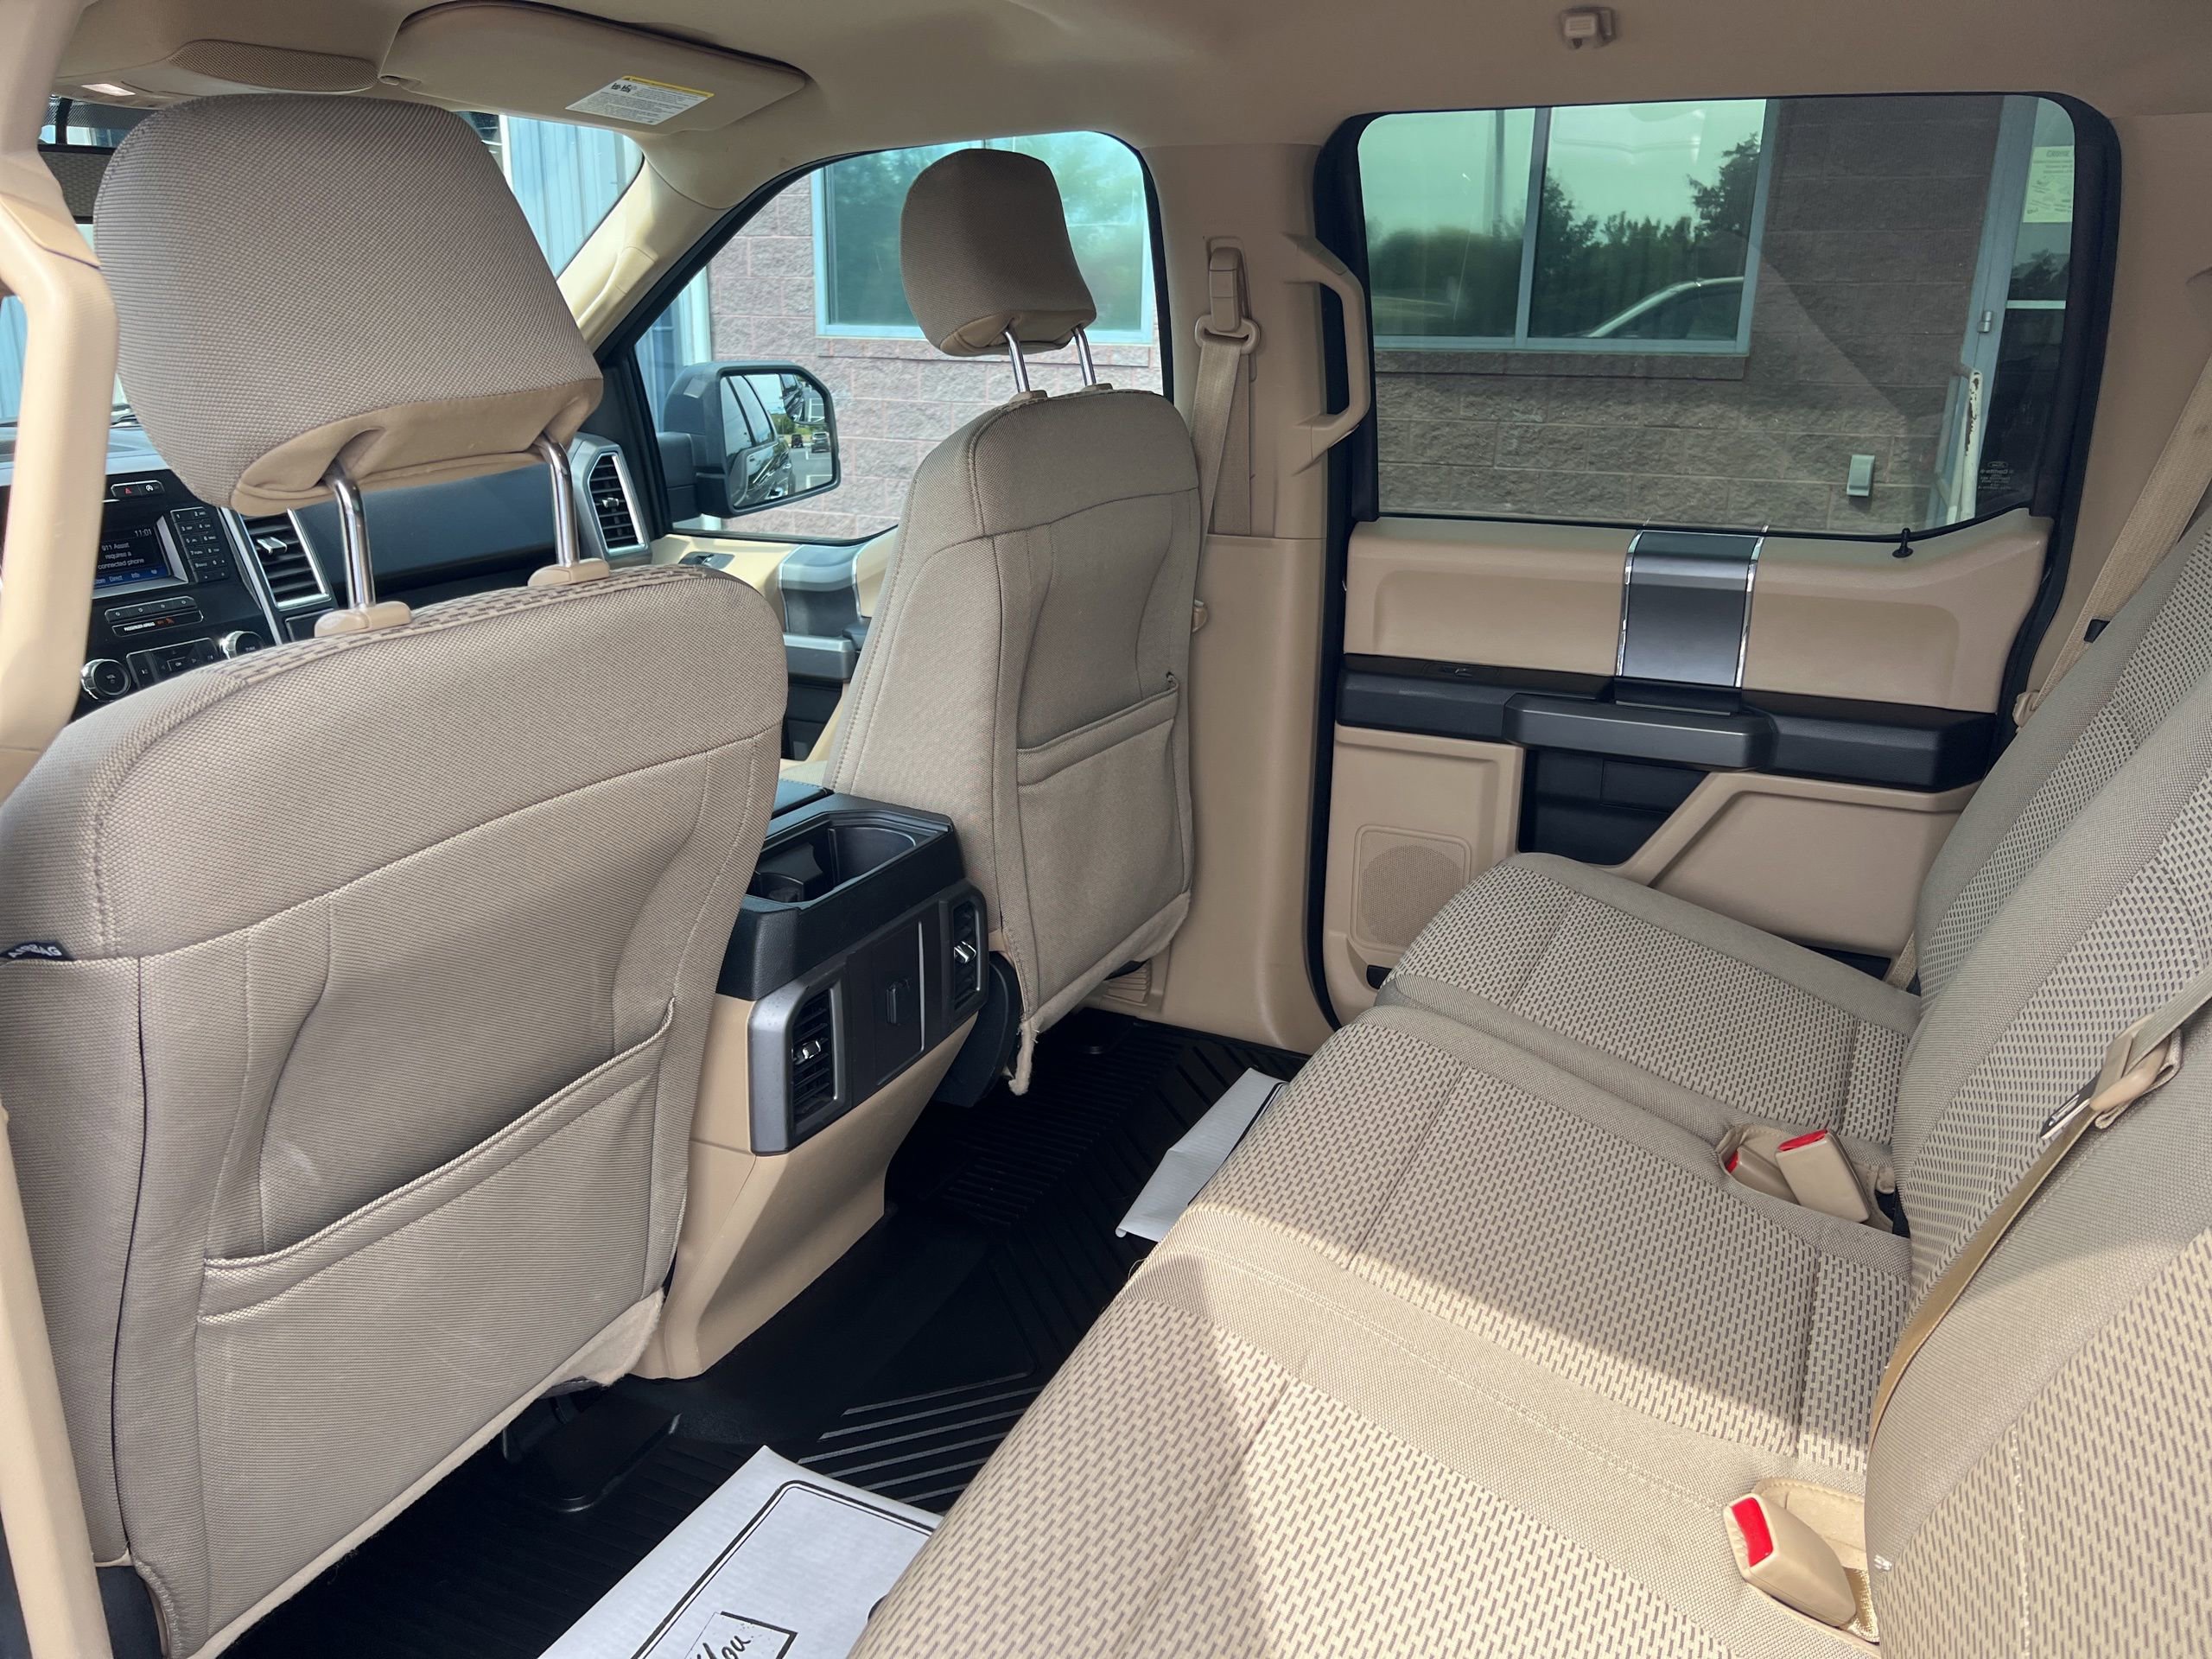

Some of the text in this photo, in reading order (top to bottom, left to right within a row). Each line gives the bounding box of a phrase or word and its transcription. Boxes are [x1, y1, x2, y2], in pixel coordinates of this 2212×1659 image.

[134, 528, 152, 537] 11:01
[97, 557, 145, 570] connected phone
[8, 944, 63, 958] AIRBAG
